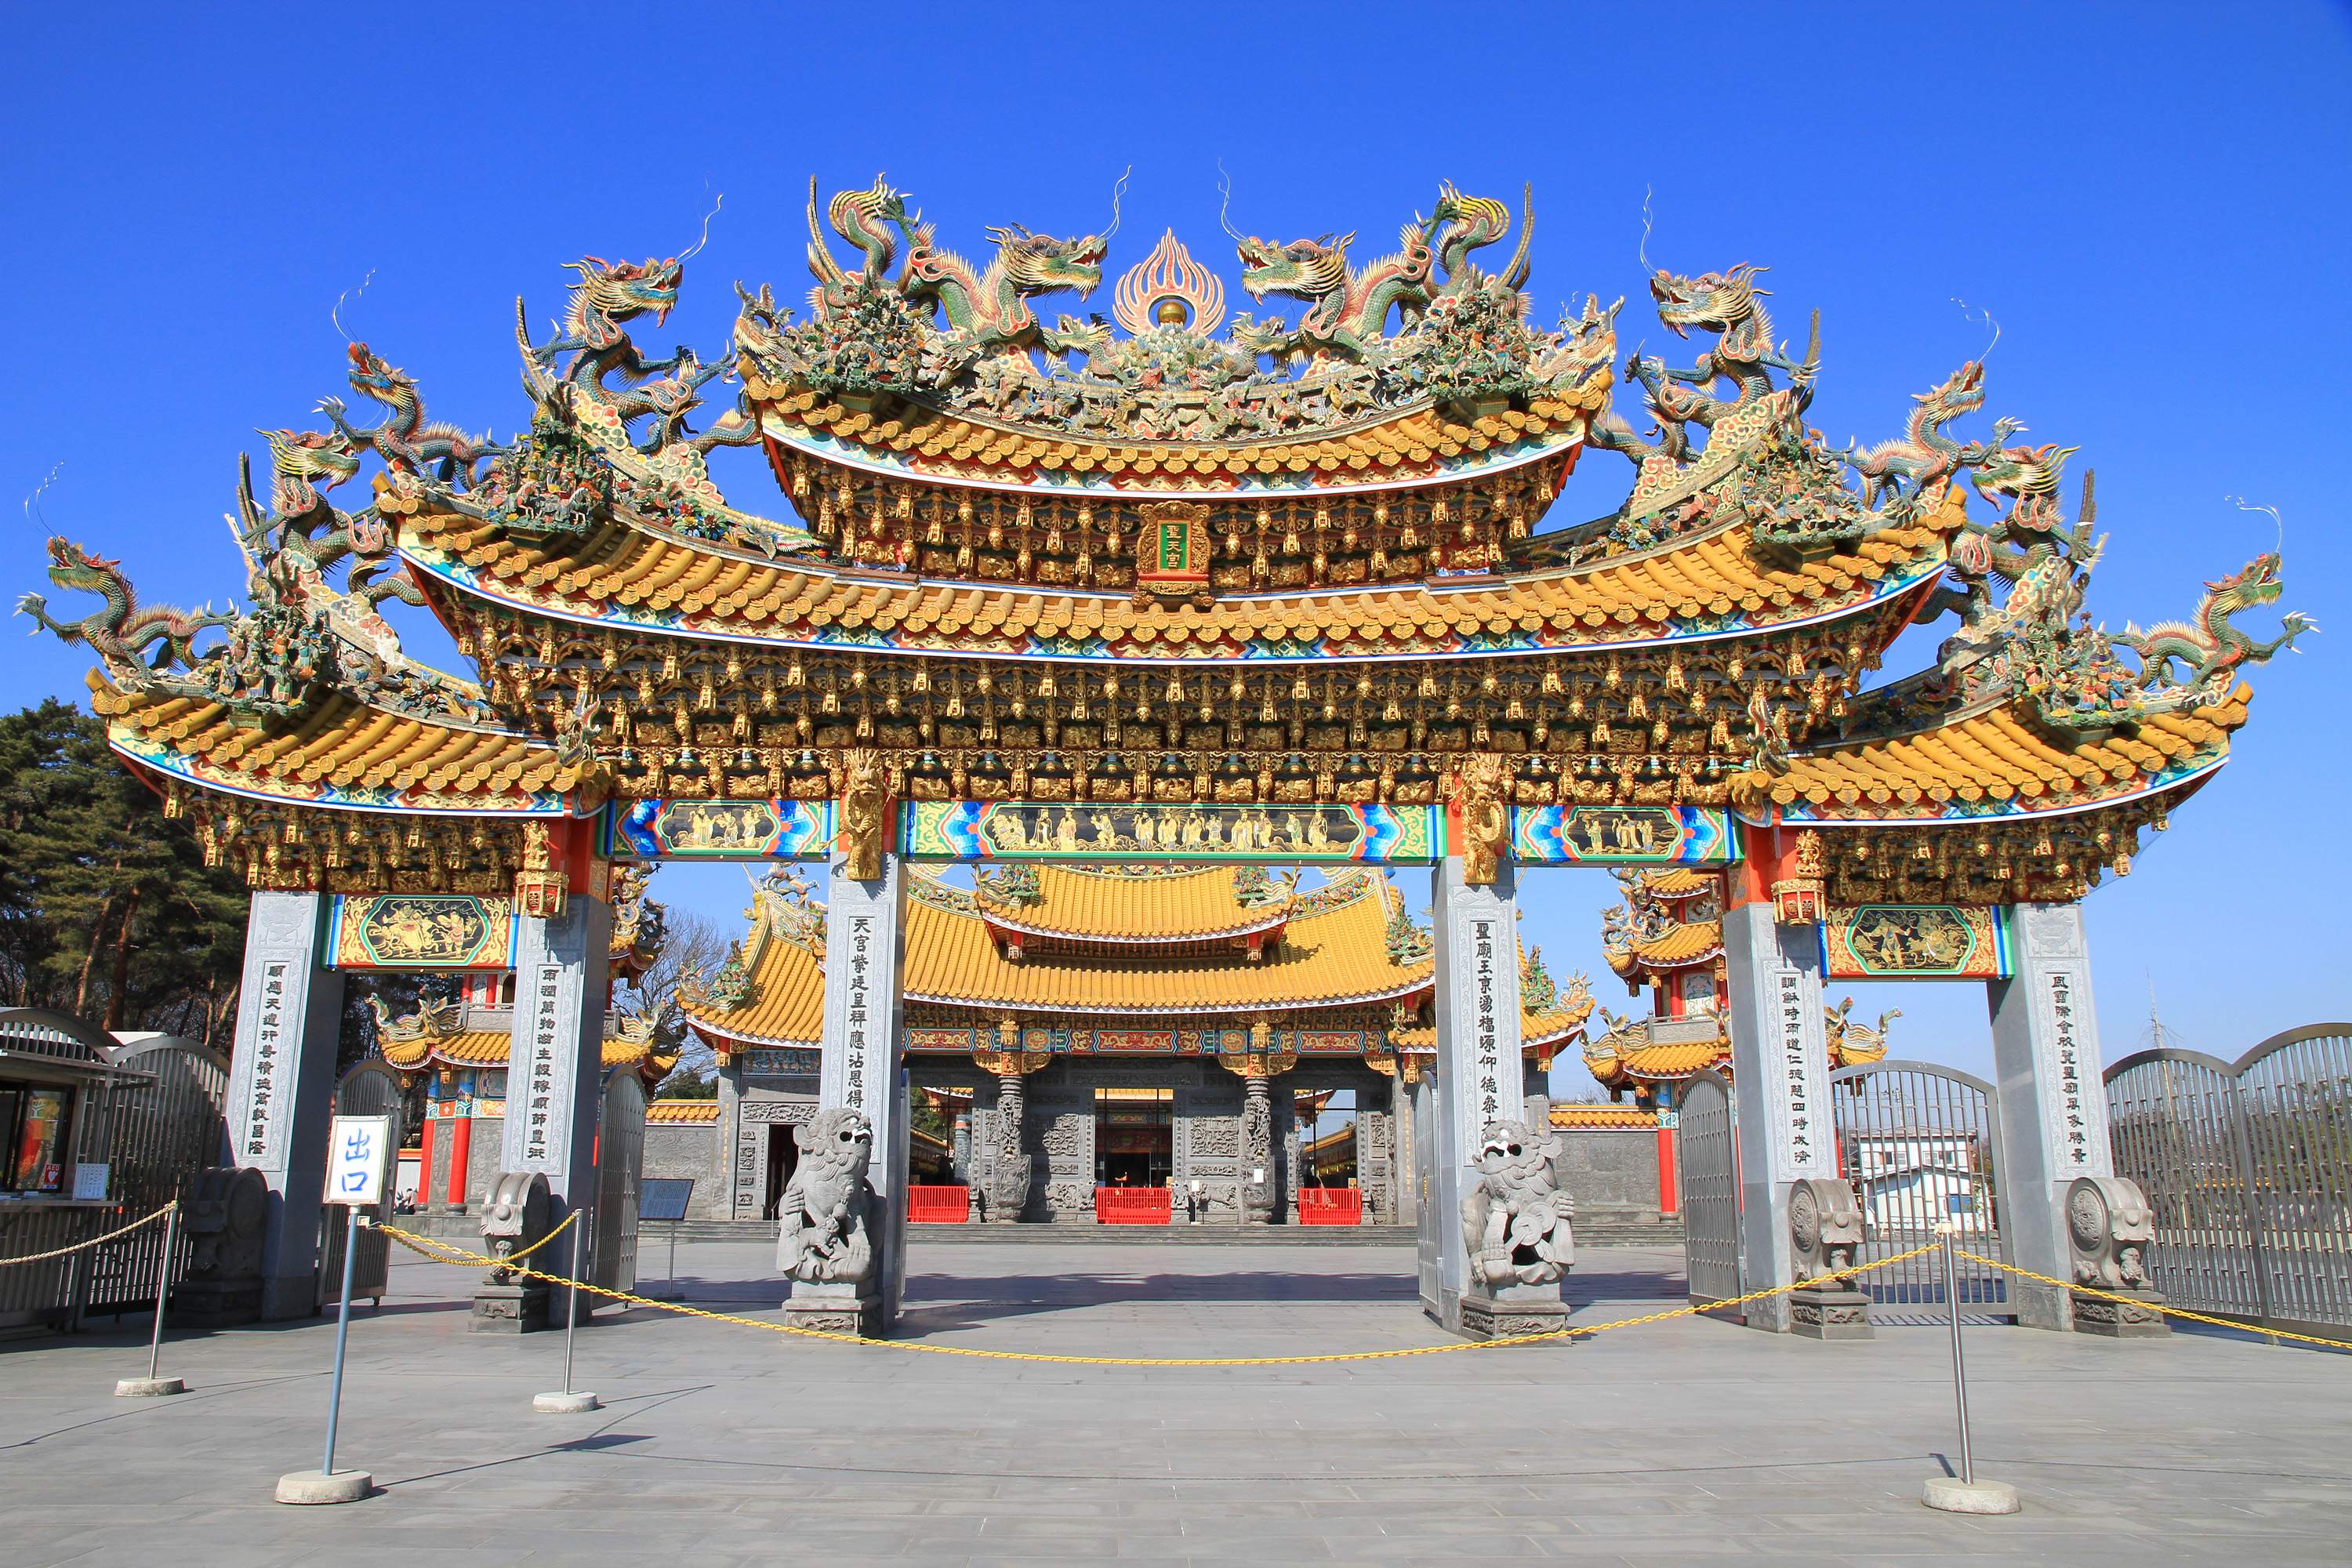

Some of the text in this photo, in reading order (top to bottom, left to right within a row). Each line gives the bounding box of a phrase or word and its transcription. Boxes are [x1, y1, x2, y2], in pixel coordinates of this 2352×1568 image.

[1166, 524, 1182, 568] 聖天宮
[341, 1127, 371, 1192] 出口
